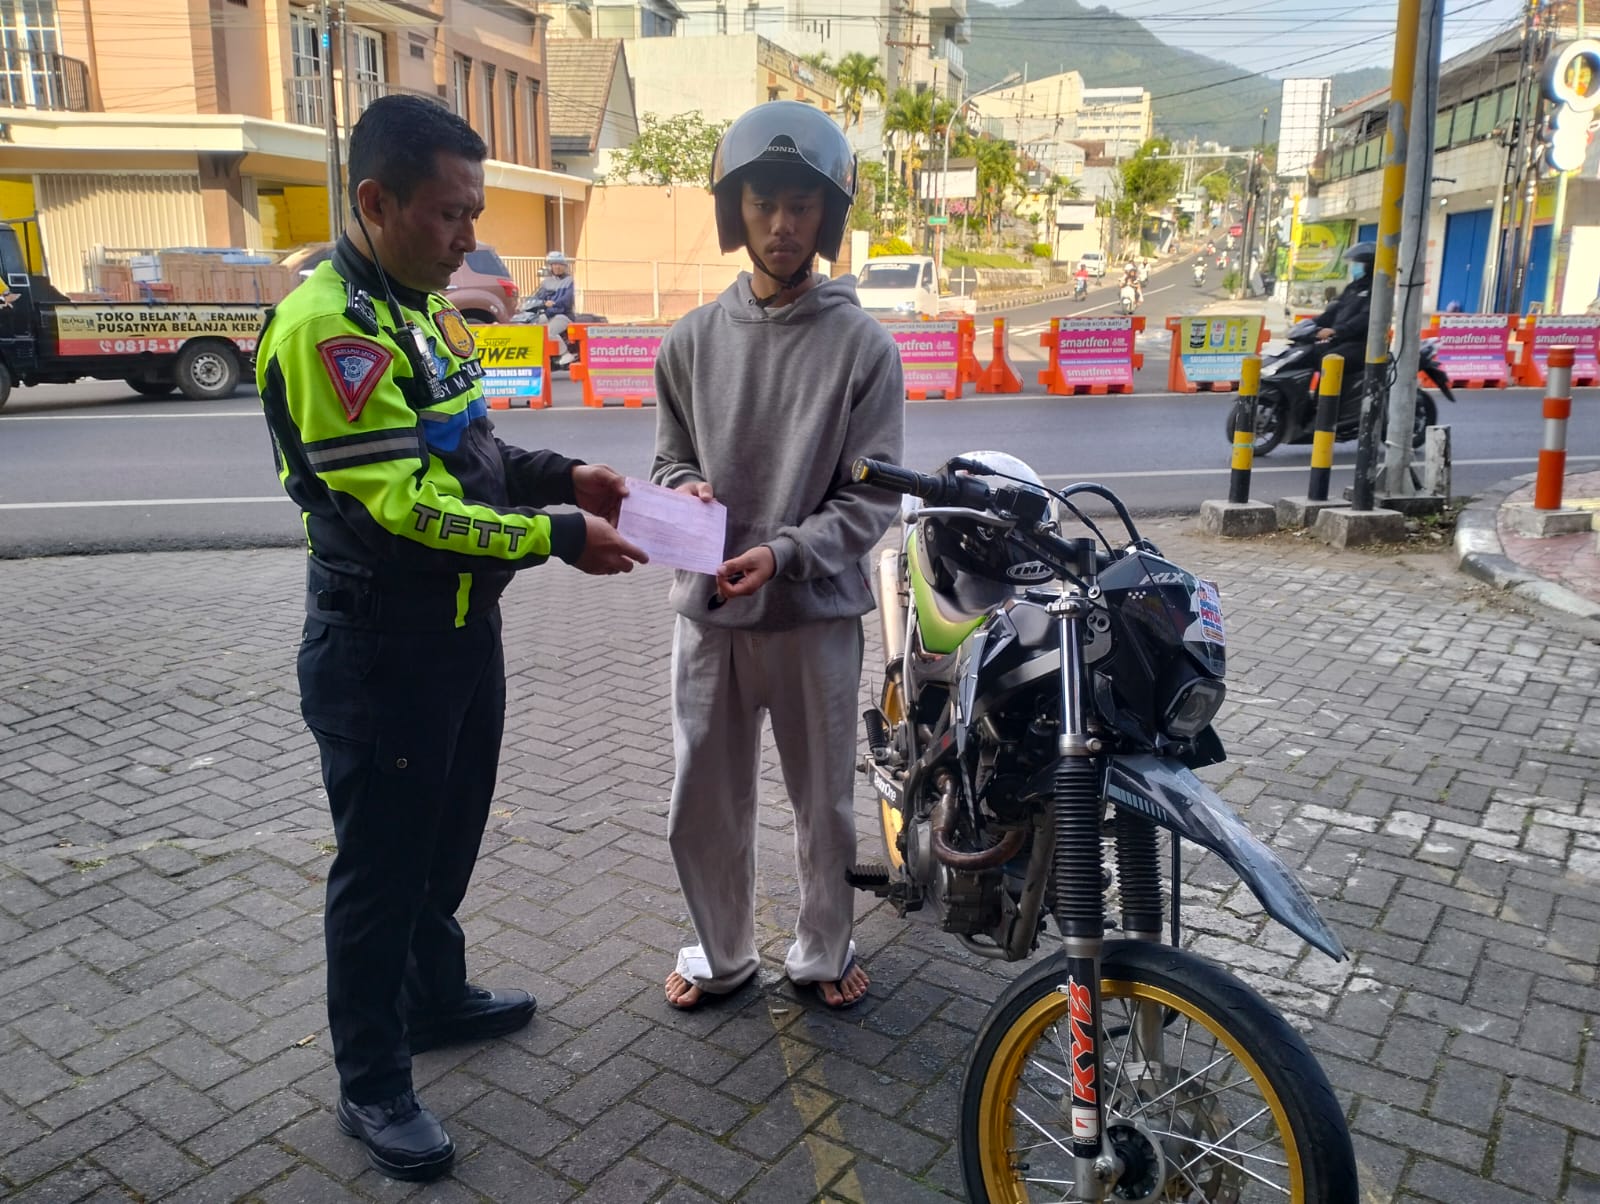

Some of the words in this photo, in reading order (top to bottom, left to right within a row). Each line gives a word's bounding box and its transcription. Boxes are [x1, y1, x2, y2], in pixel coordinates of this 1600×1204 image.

[95, 312, 134, 321] TOKO
[97, 323, 167, 332] PUSATNYA
[172, 322, 227, 332] BELANJA
[1060, 337, 1109, 348] smartfren
[1439, 333, 1486, 344] smartfren
[1535, 333, 1579, 344] smartfren
[590, 344, 648, 356] smartfren
[412, 503, 527, 552] TFTT
[1139, 572, 1184, 585] KLX
[1069, 980, 1097, 1104] KYB
